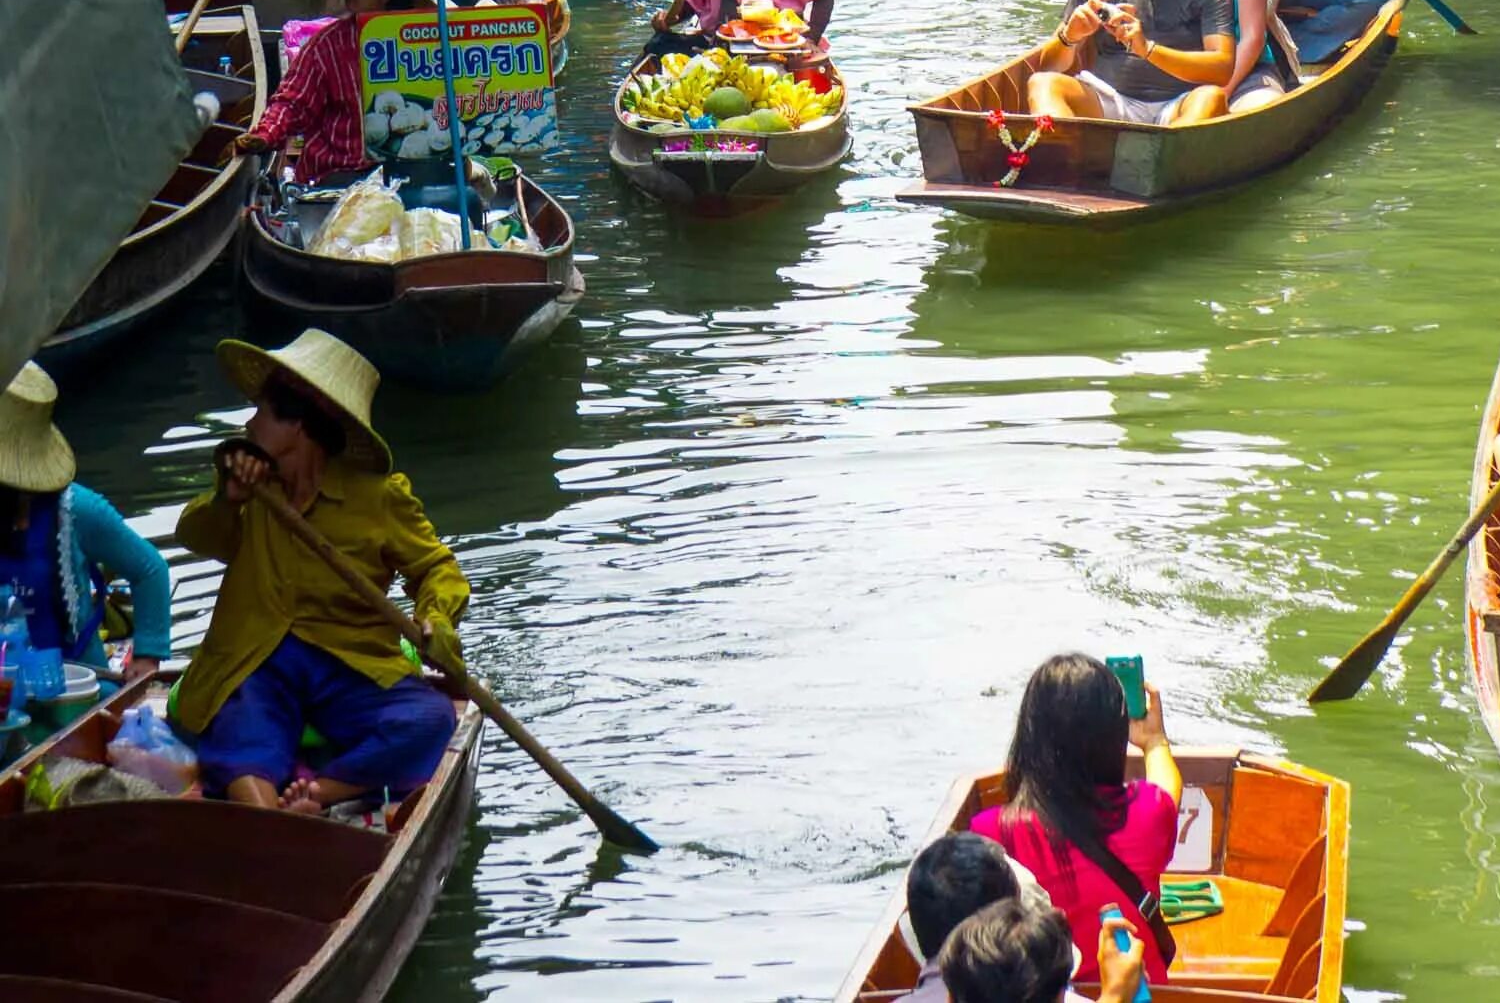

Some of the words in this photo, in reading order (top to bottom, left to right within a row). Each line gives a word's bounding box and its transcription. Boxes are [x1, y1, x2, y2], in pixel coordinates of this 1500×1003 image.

[402, 24, 465, 41] COCOUT
[471, 20, 537, 37] PANCAKE
[364, 39, 545, 83] ขนมครก
